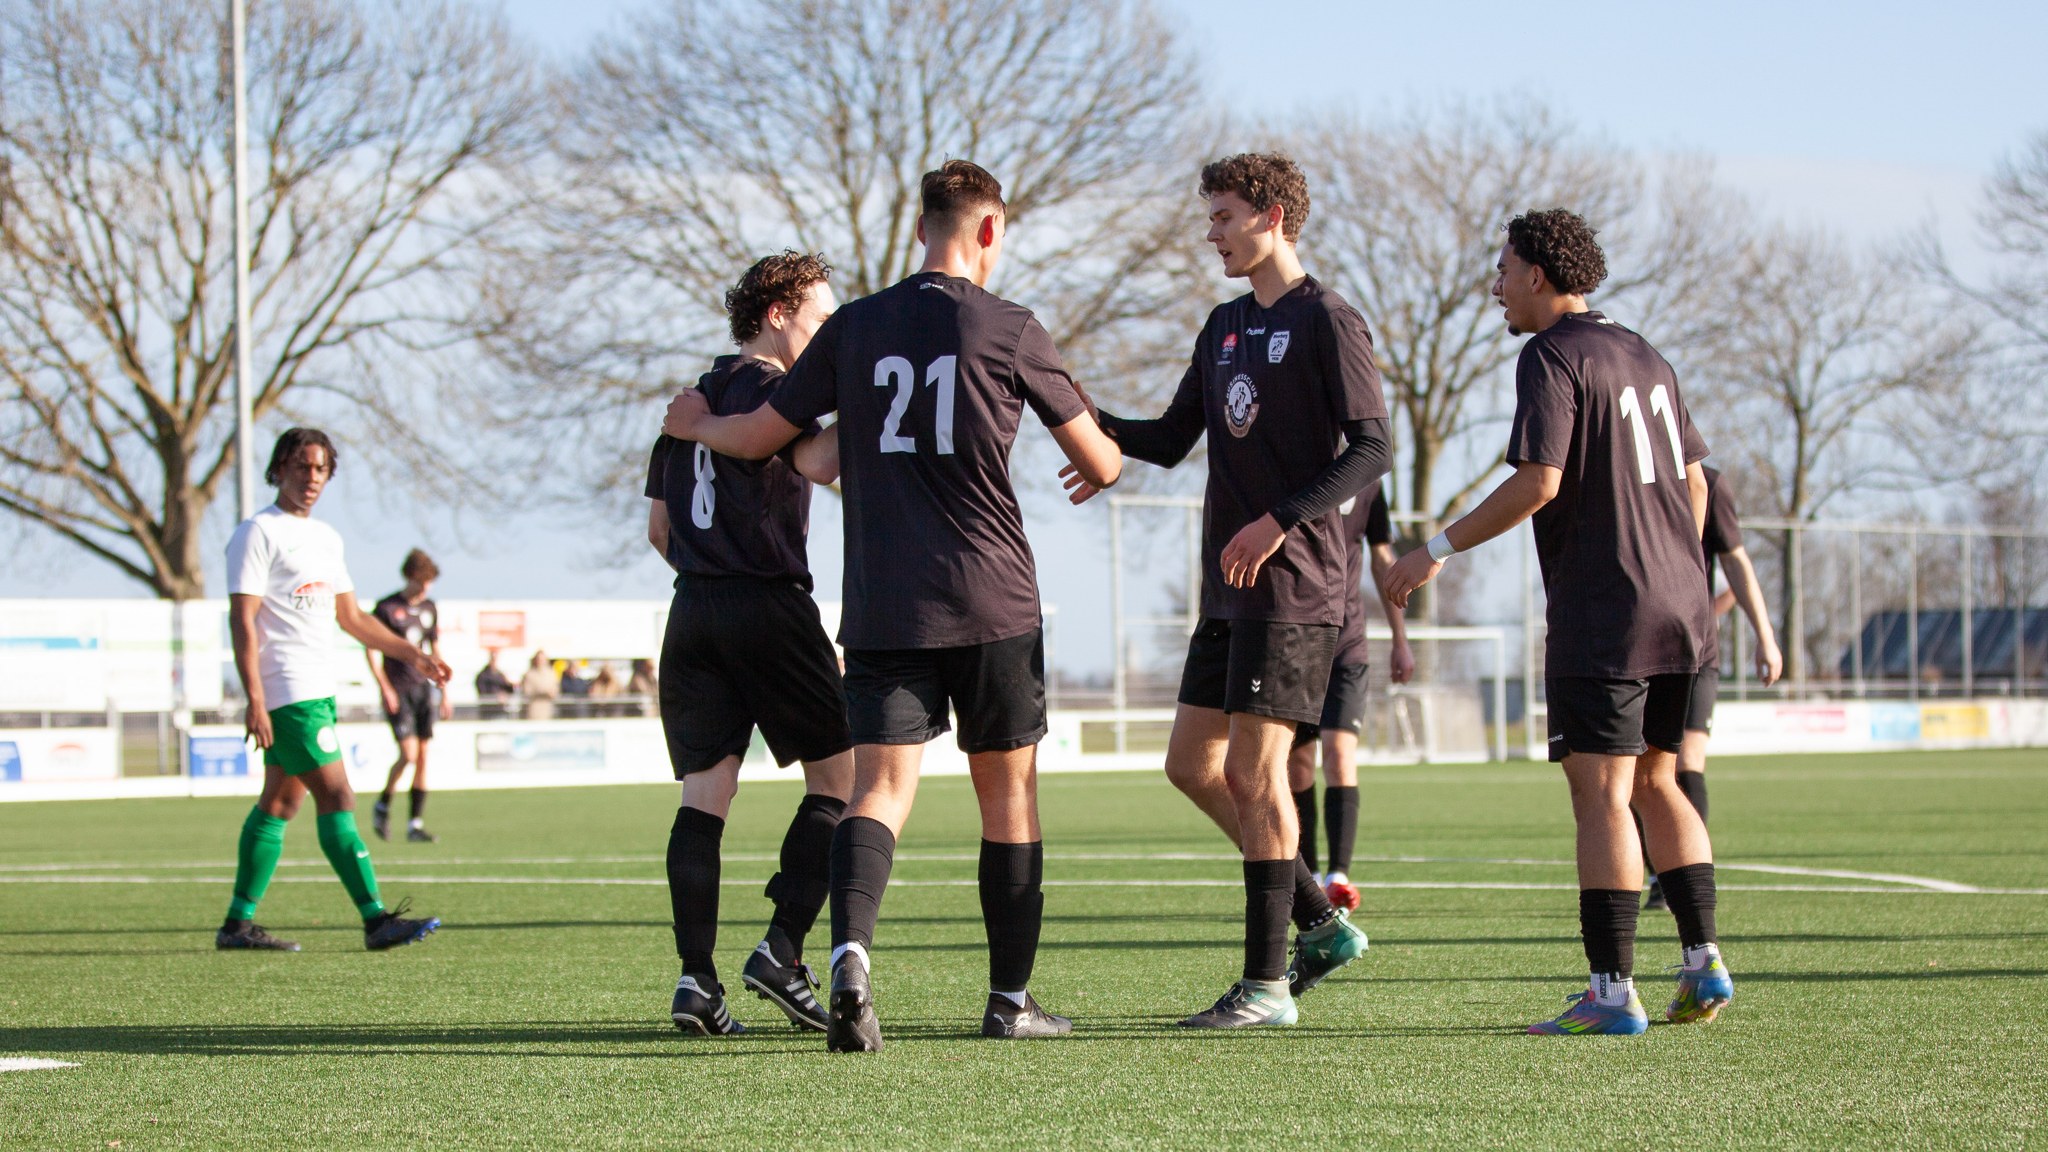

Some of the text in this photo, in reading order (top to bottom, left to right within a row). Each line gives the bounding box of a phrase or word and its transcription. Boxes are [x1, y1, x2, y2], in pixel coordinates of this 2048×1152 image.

[874, 355, 957, 455] 21
[1619, 384, 1687, 484] 11
[691, 441, 716, 529] 8
